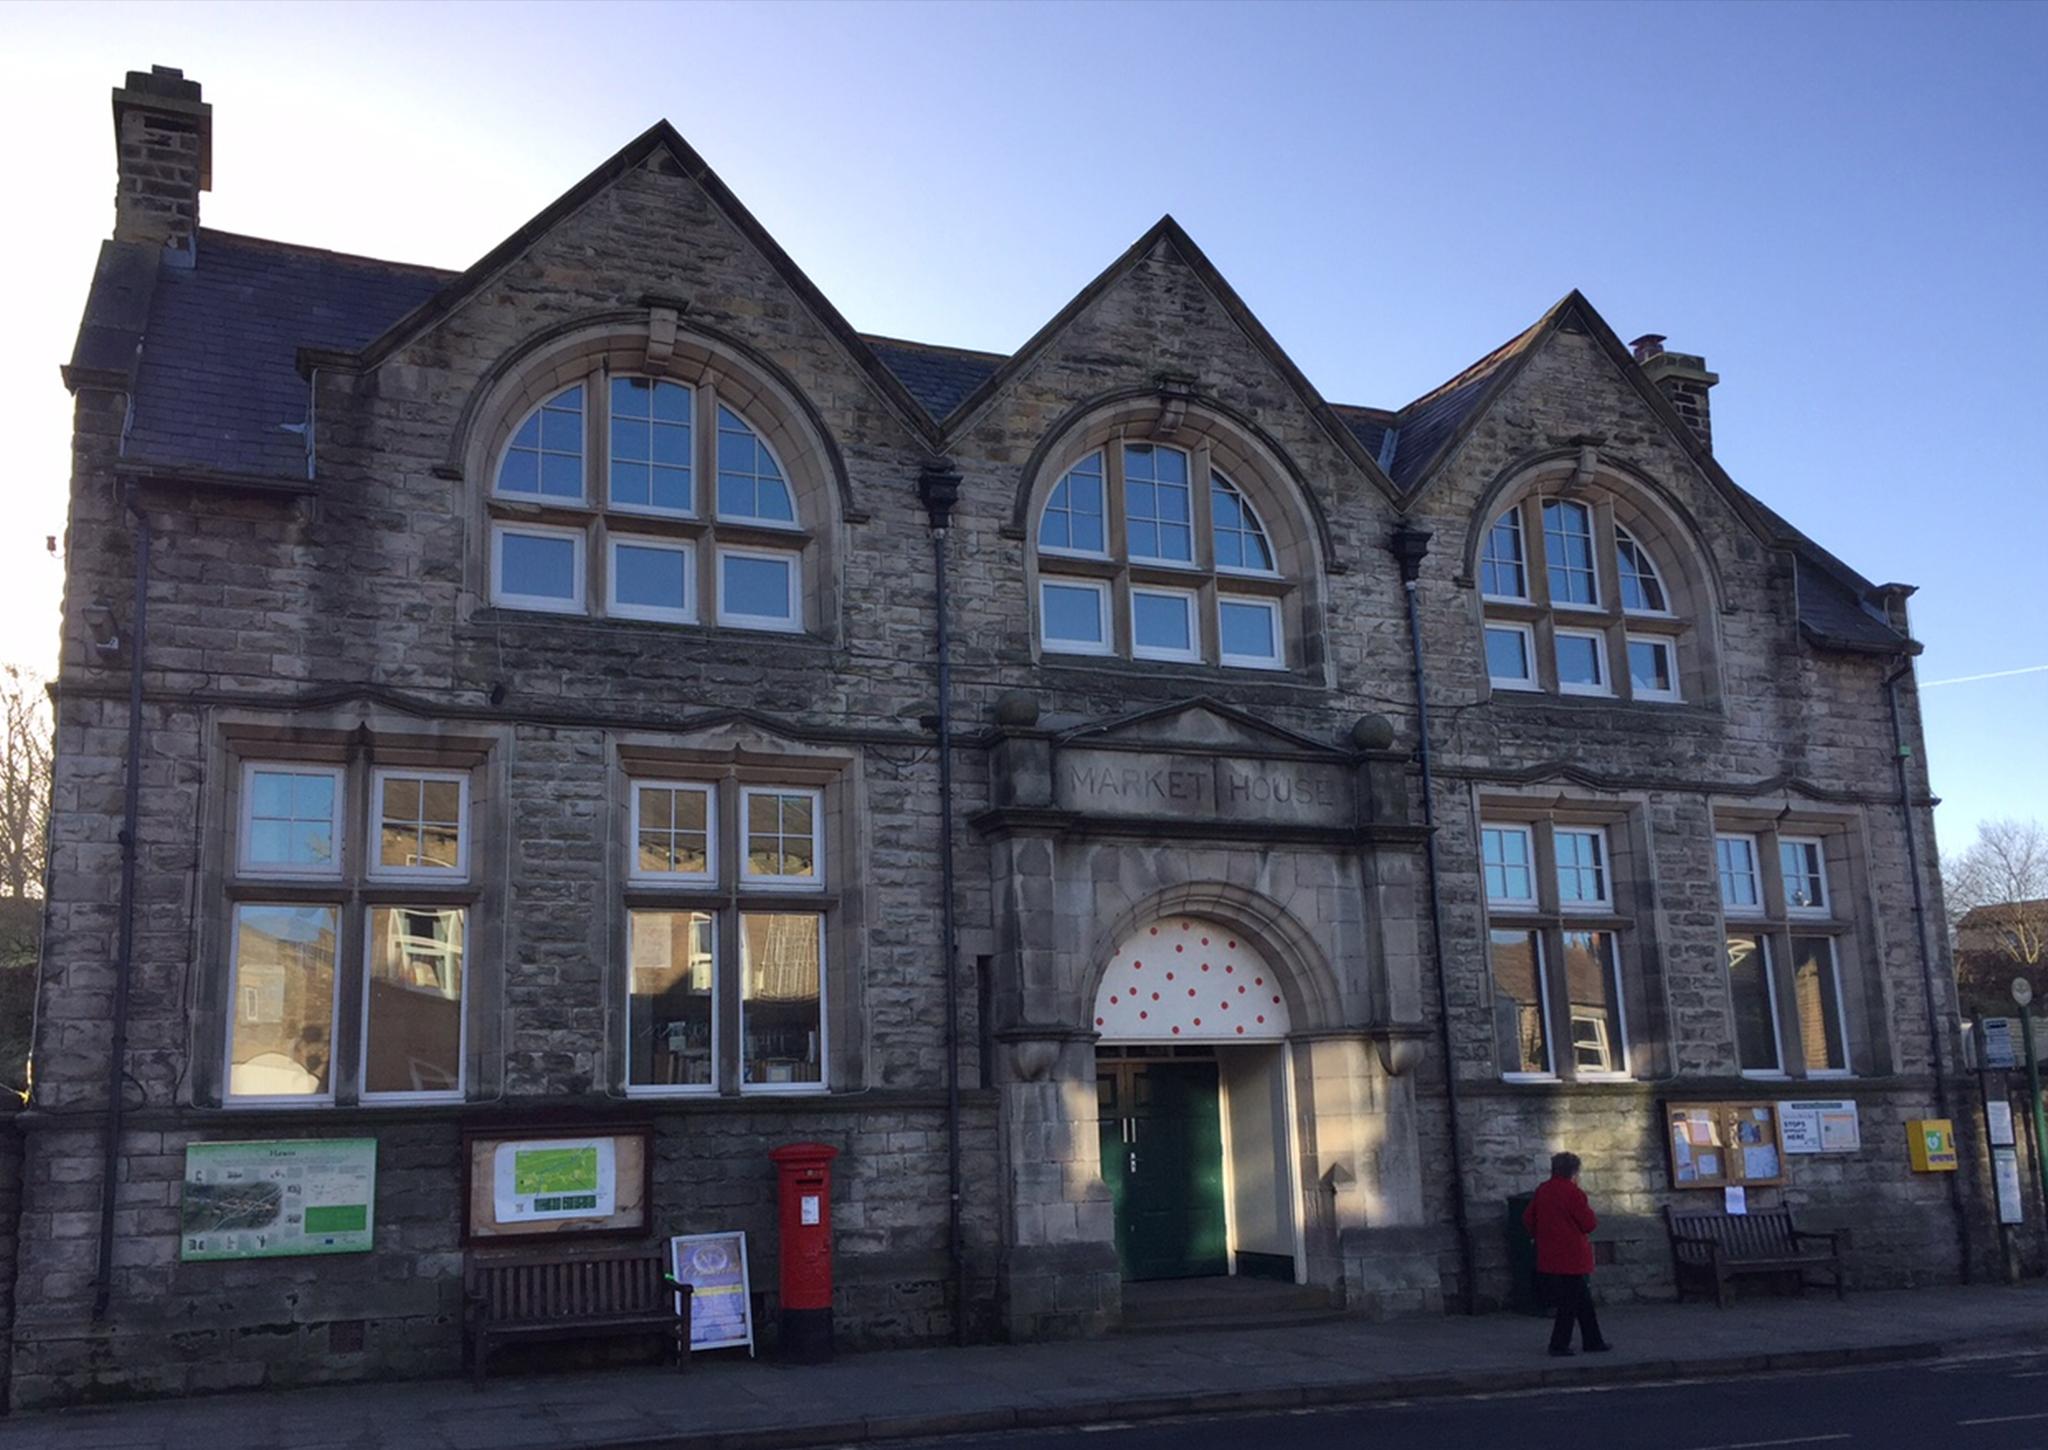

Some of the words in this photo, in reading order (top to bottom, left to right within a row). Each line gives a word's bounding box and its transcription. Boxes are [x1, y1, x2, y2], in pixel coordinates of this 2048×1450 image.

[1070, 765, 1208, 802] MARKET
[1228, 773, 1334, 807] HOUSE
[1786, 1133, 1805, 1141] HERE
